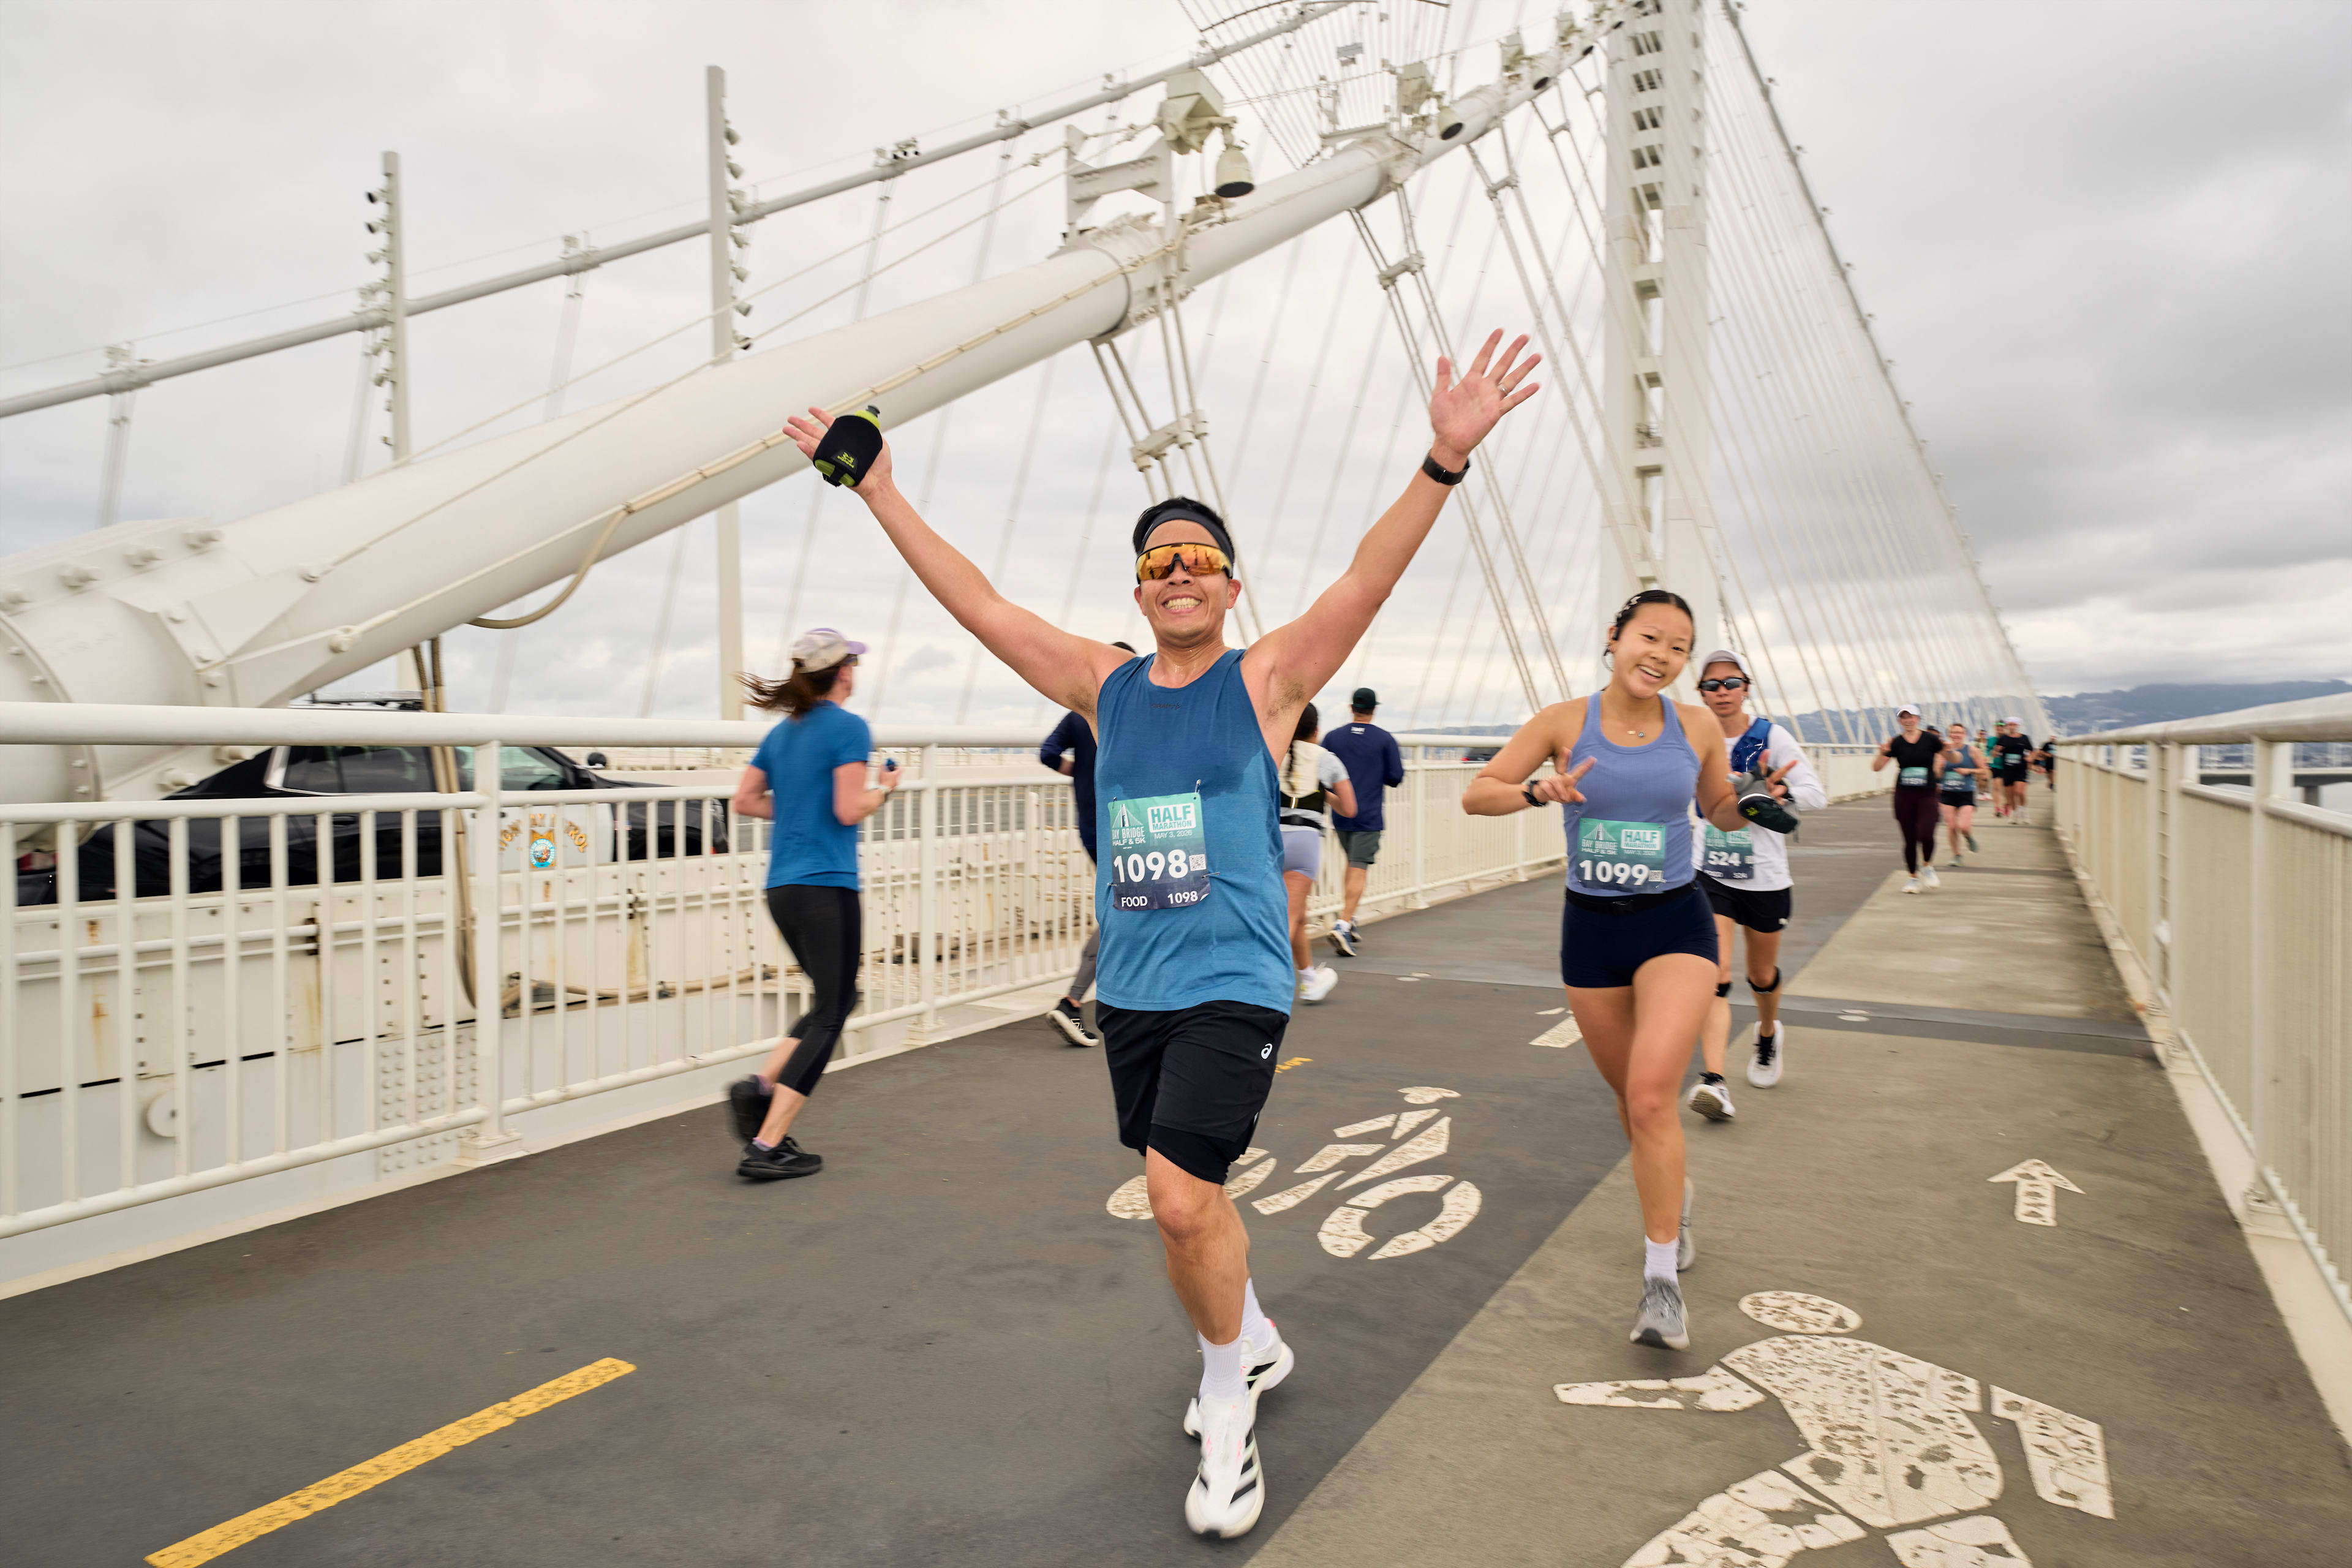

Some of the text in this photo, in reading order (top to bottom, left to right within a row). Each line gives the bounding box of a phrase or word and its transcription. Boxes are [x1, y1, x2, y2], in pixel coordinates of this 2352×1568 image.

[1151, 805, 1191, 823] HALF
[1122, 826, 1145, 839] BRIDGE
[1153, 820, 1191, 831] MARATHON
[1582, 839, 1618, 850] BAY BRIDGE
[1625, 831, 1656, 843] HALF
[1114, 849, 1188, 883] 1098
[1708, 851, 1741, 866] 524
[1578, 859, 1649, 886] 1099
[1121, 891, 1198, 907] FOOD 1098
